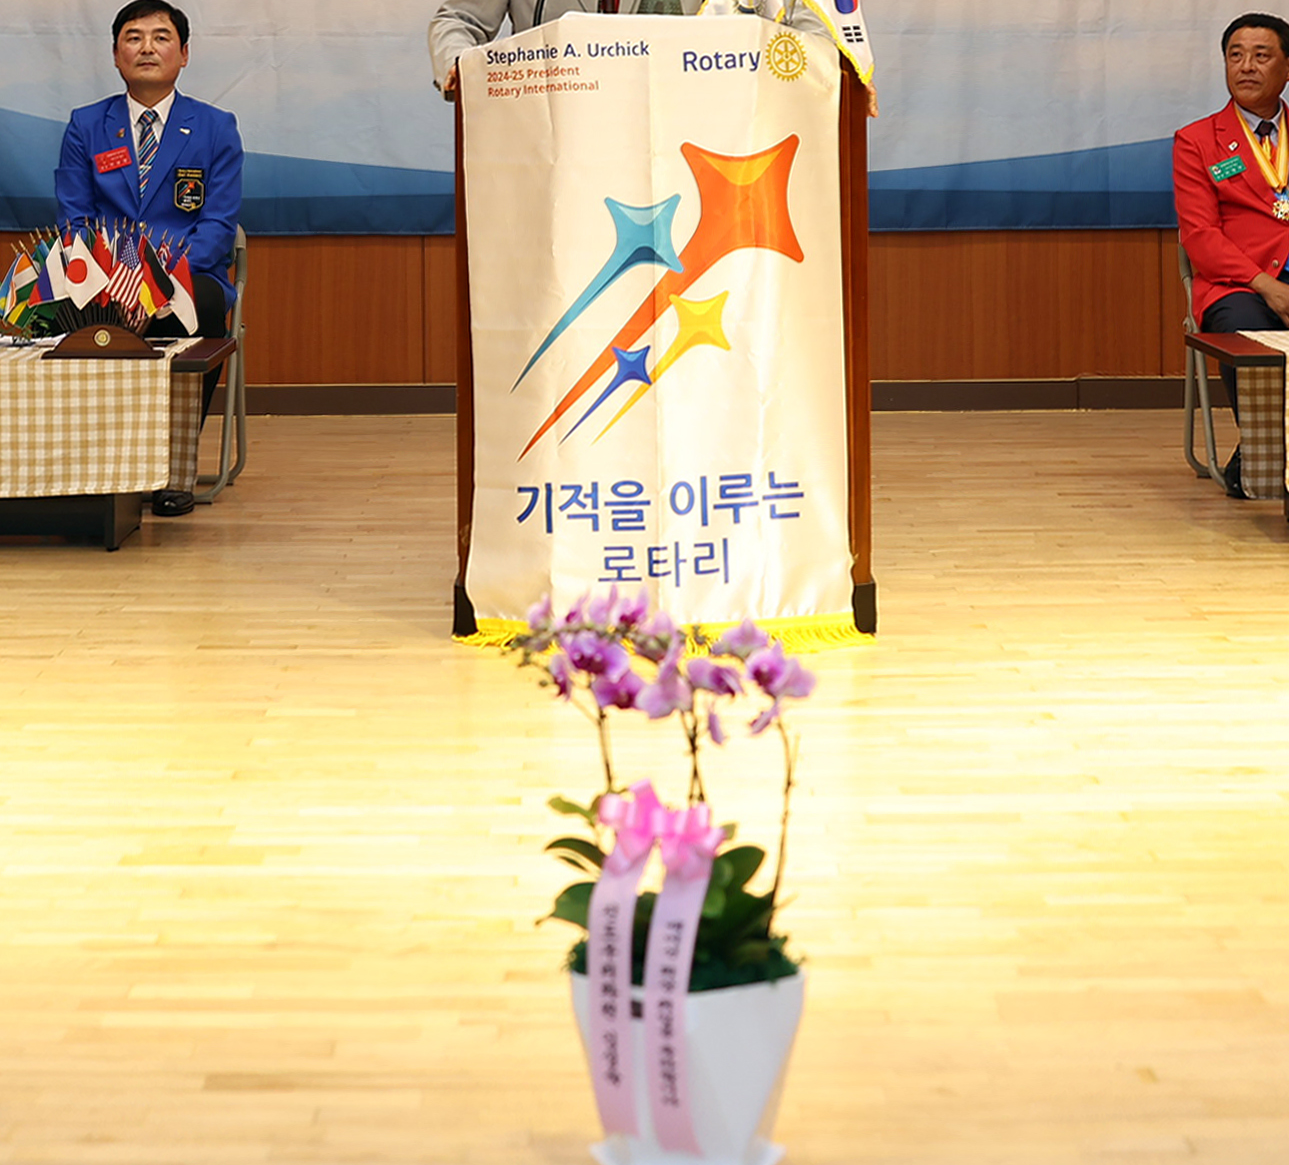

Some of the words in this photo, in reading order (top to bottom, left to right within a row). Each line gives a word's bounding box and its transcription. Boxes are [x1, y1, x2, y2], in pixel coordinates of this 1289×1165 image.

[486, 44, 558, 66] Stephanie
[563, 43, 581, 58] A.
[587, 40, 650, 57] Urchick
[682, 46, 762, 74] Rotary
[487, 70, 524, 83] 2024-25
[527, 66, 580, 80] President
[488, 86, 522, 98] Rotary
[524, 80, 599, 95] International
[516, 480, 651, 534] 기적을
[669, 471, 804, 527] 이루는
[598, 538, 729, 587] 로타리
